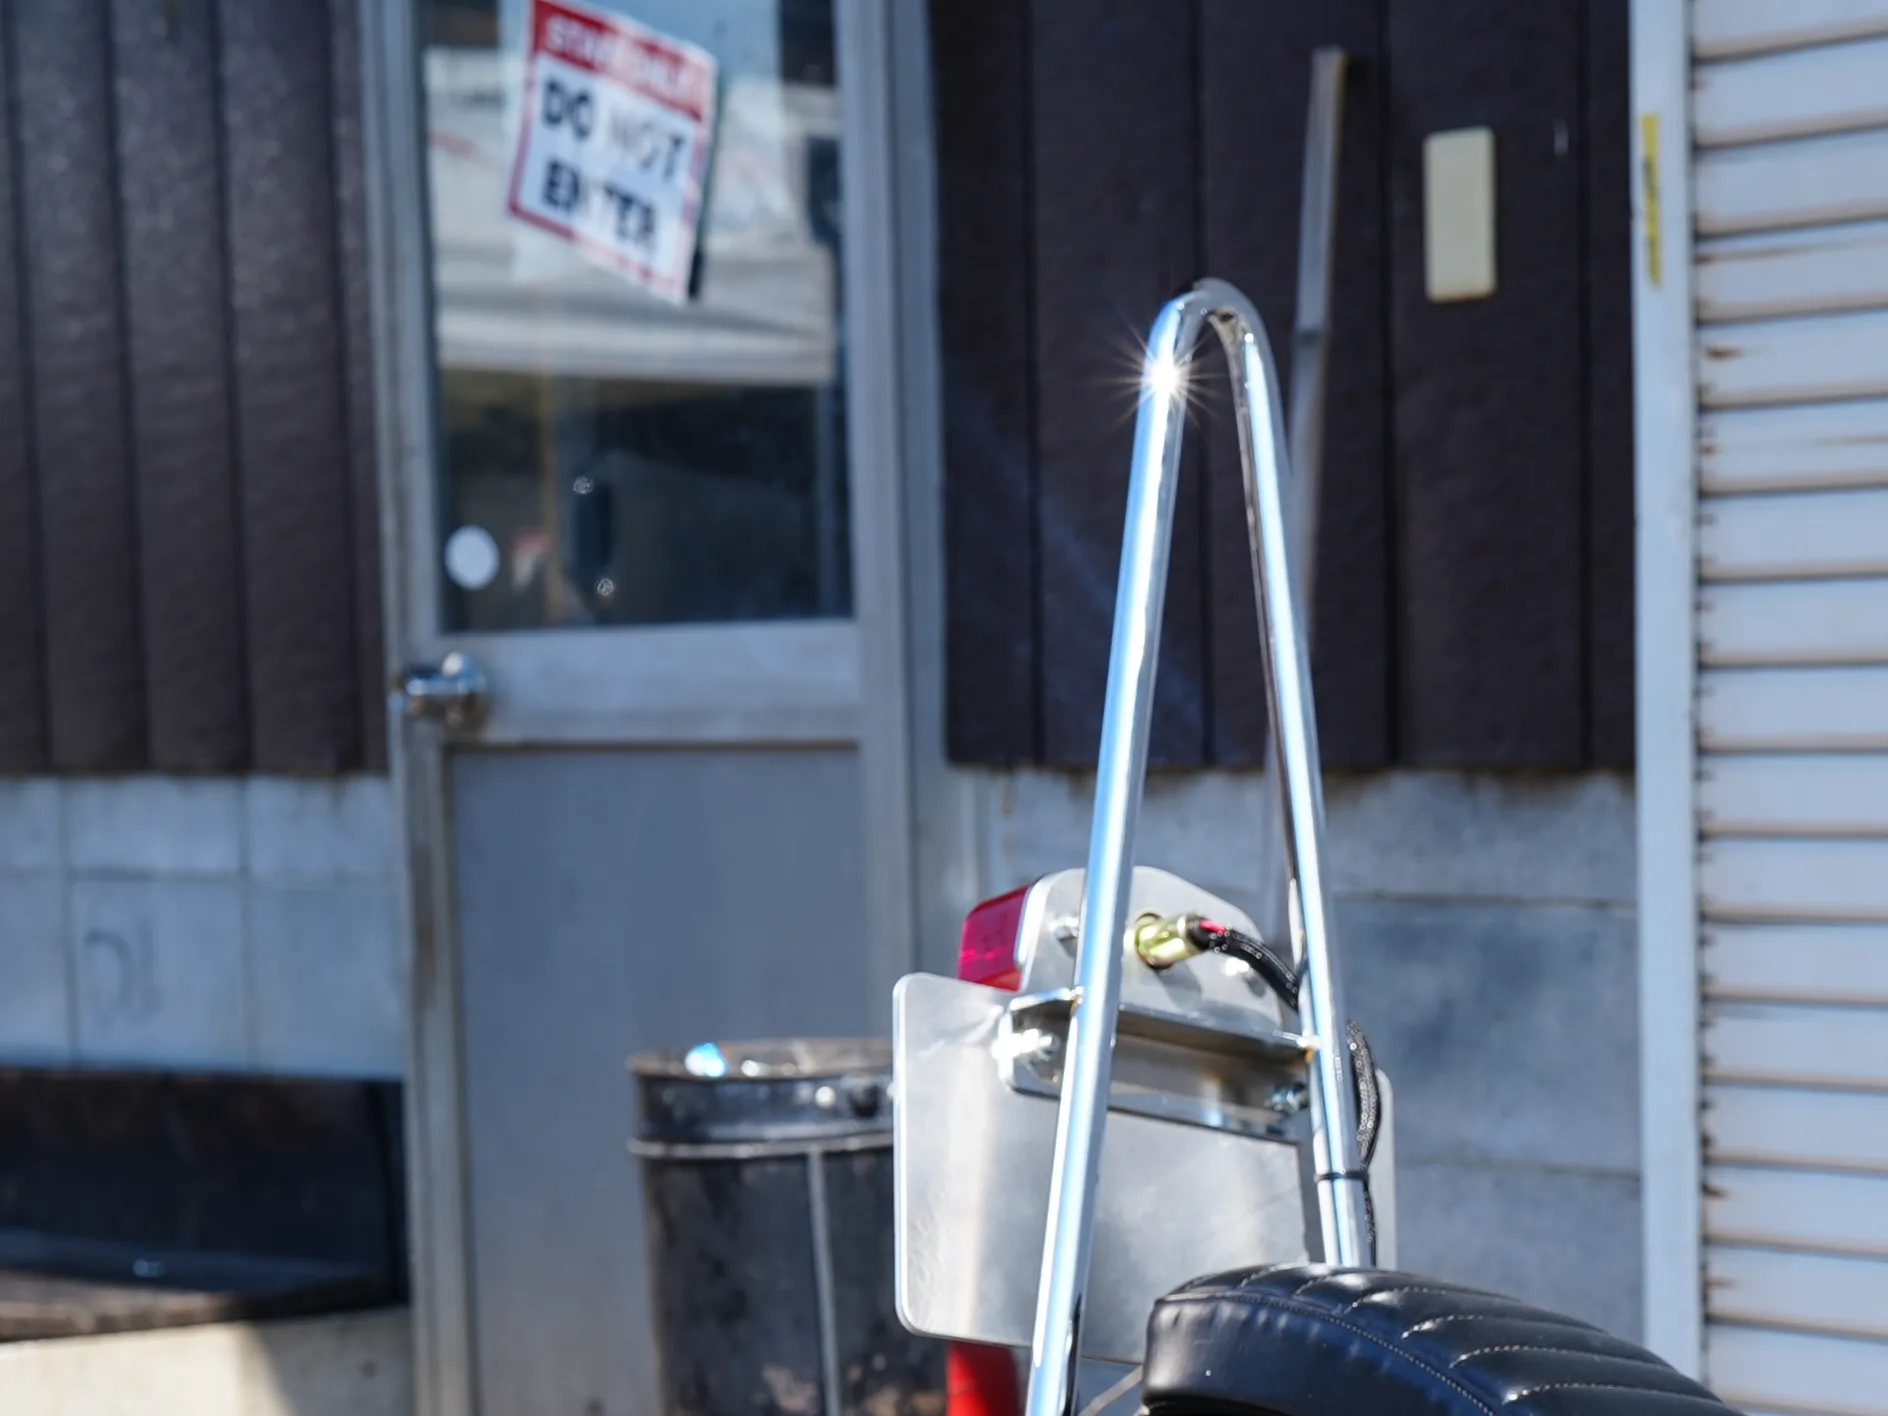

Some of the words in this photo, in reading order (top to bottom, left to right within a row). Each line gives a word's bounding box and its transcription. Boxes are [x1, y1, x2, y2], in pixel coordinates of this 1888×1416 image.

[541, 77, 594, 142] DO
[608, 106, 685, 184] NOT
[542, 160, 656, 245] ENTER
